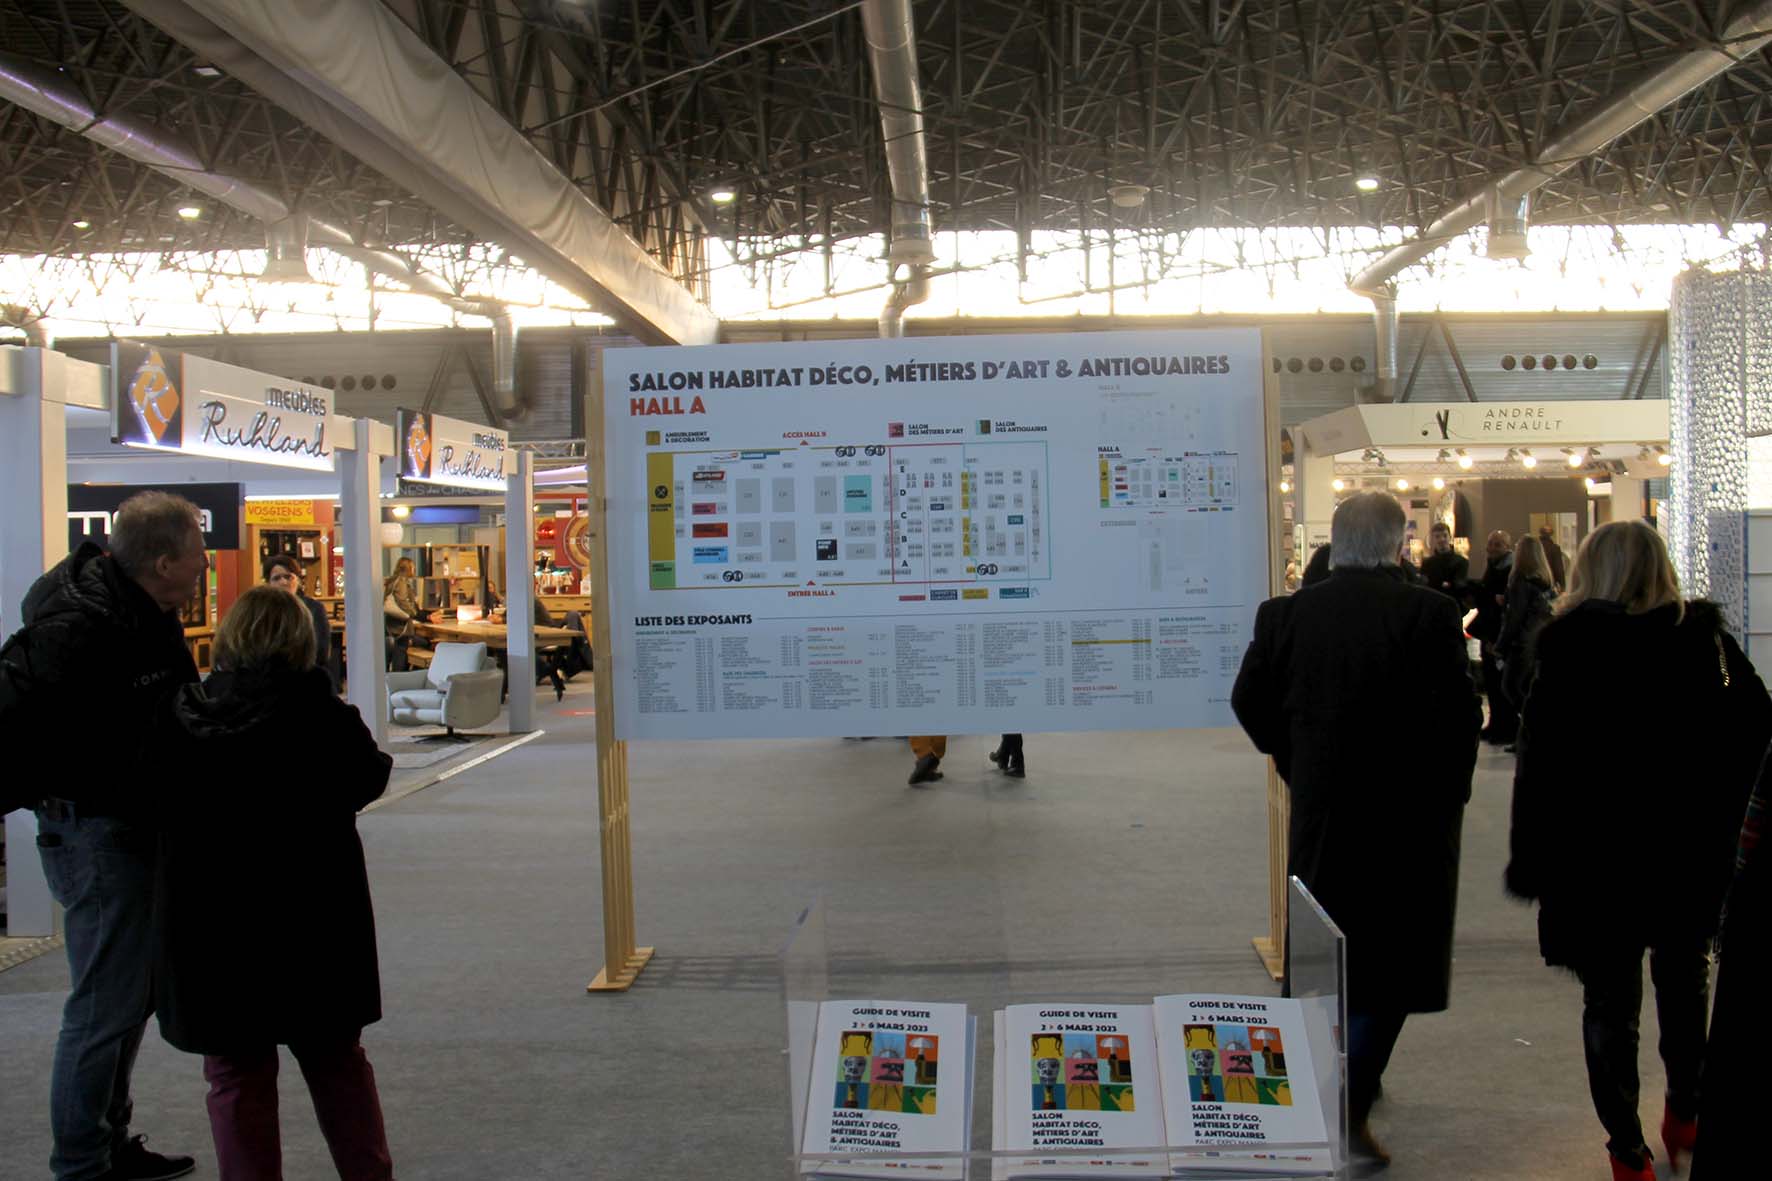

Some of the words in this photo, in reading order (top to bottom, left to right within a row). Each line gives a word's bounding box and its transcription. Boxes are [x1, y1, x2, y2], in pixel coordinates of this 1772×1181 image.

[629, 371, 703, 392] SALON
[709, 368, 804, 389] HABITAT
[809, 362, 879, 386] DÉCO,
[885, 359, 977, 383] MÉTIERS
[982, 360, 1050, 380] D'ART
[1055, 361, 1073, 378] &
[1078, 355, 1231, 377] ANTIQUAIRES
[265, 387, 327, 416] meubles
[630, 397, 684, 416] HALL
[689, 396, 706, 415] A
[1486, 408, 1545, 418] ANDRE
[199, 400, 330, 457] Ruhland
[1483, 420, 1563, 431] RENAULT
[439, 445, 505, 480] Ruhland
[900, 465, 905, 473] E
[900, 488, 906, 497] D
[248, 506, 304, 516] VOSGIENS
[900, 511, 907, 519] C
[901, 535, 907, 543] B
[901, 559, 908, 567] A
[635, 616, 663, 626] LISTE
[665, 615, 685, 626] DES
[687, 614, 753, 625] EXPOSANTS
[1189, 1001, 1220, 1009] GUIDE
[1236, 1002, 1267, 1011] VISITE
[852, 1008, 883, 1016] GUIDE
[886, 1009, 898, 1017] DE
[900, 1009, 931, 1018] VISITE
[1039, 1010, 1070, 1018] GUIDE
[1073, 1010, 1085, 1018] DE
[1088, 1011, 1118, 1019] VISITE
[1216, 1015, 1244, 1023] MARS
[1246, 1016, 1268, 1025] 2023
[876, 1022, 904, 1031] MARS
[907, 1024, 928, 1032] 2023
[1065, 1024, 1093, 1032] MARS
[1095, 1024, 1117, 1033] 2023
[1192, 1104, 1222, 1112] SALON
[832, 1111, 863, 1119] SALON
[1192, 1113, 1231, 1121] HABITAT
[1233, 1113, 1262, 1123] DÉCO,
[831, 1119, 870, 1128] HABITAT
[872, 1121, 901, 1132] DÉCO,
[1032, 1121, 1071, 1129] HABITAT
[1072, 1120, 1102, 1130] DÉCO,
[1193, 1121, 1231, 1129] MÉTIERS
[1232, 1121, 1260, 1130] D'ART
[831, 1127, 868, 1137] MÉTIERS
[870, 1129, 897, 1139] D'ART
[1032, 1127, 1070, 1137] MÉTIERS
[1071, 1129, 1099, 1137] D'ART
[1204, 1130, 1266, 1139] ANTIQUAIRES
[839, 1136, 901, 1148] ANTIQUAIRES
[1033, 1138, 1040, 1146] &
[1041, 1138, 1104, 1146] ANTIQUAIRES
